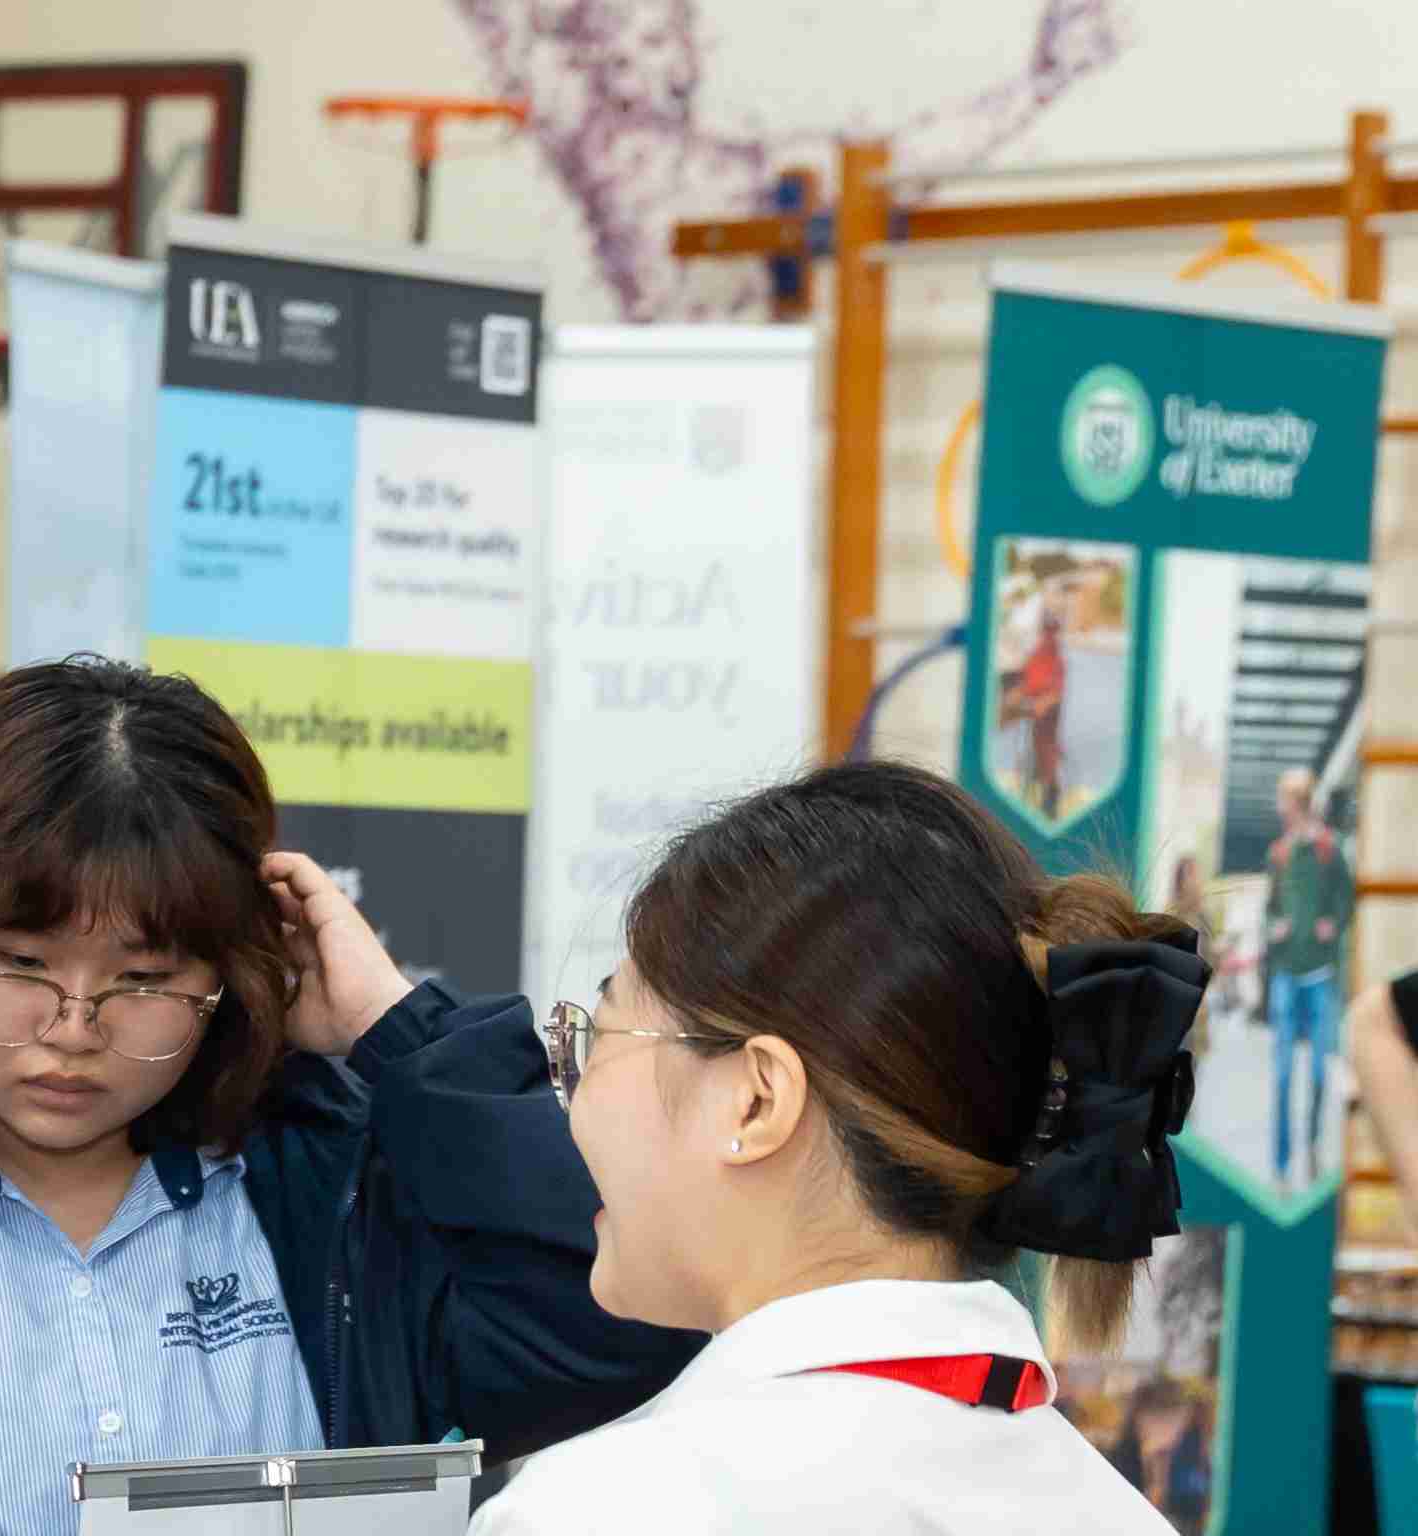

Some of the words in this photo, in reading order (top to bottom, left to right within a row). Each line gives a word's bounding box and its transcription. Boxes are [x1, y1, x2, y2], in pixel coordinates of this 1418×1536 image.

[1163, 394, 1317, 463] University
[183, 451, 262, 518] 21st
[380, 707, 510, 757] available
